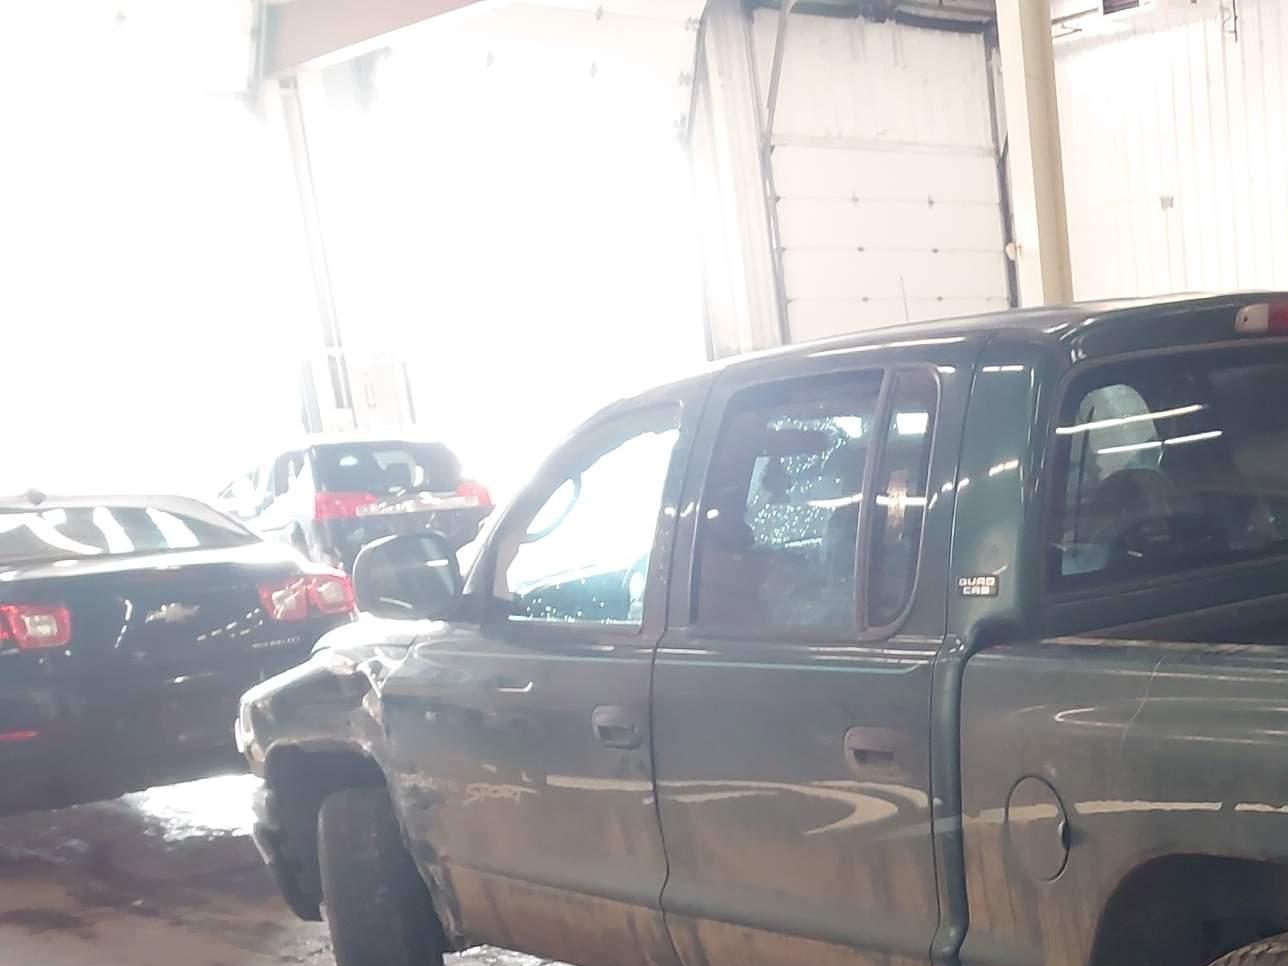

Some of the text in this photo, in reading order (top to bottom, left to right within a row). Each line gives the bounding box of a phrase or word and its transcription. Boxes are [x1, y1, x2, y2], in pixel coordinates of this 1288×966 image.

[958, 577, 996, 586] QUAD
[962, 586, 990, 595] CAB
[462, 782, 538, 806] SPORT
